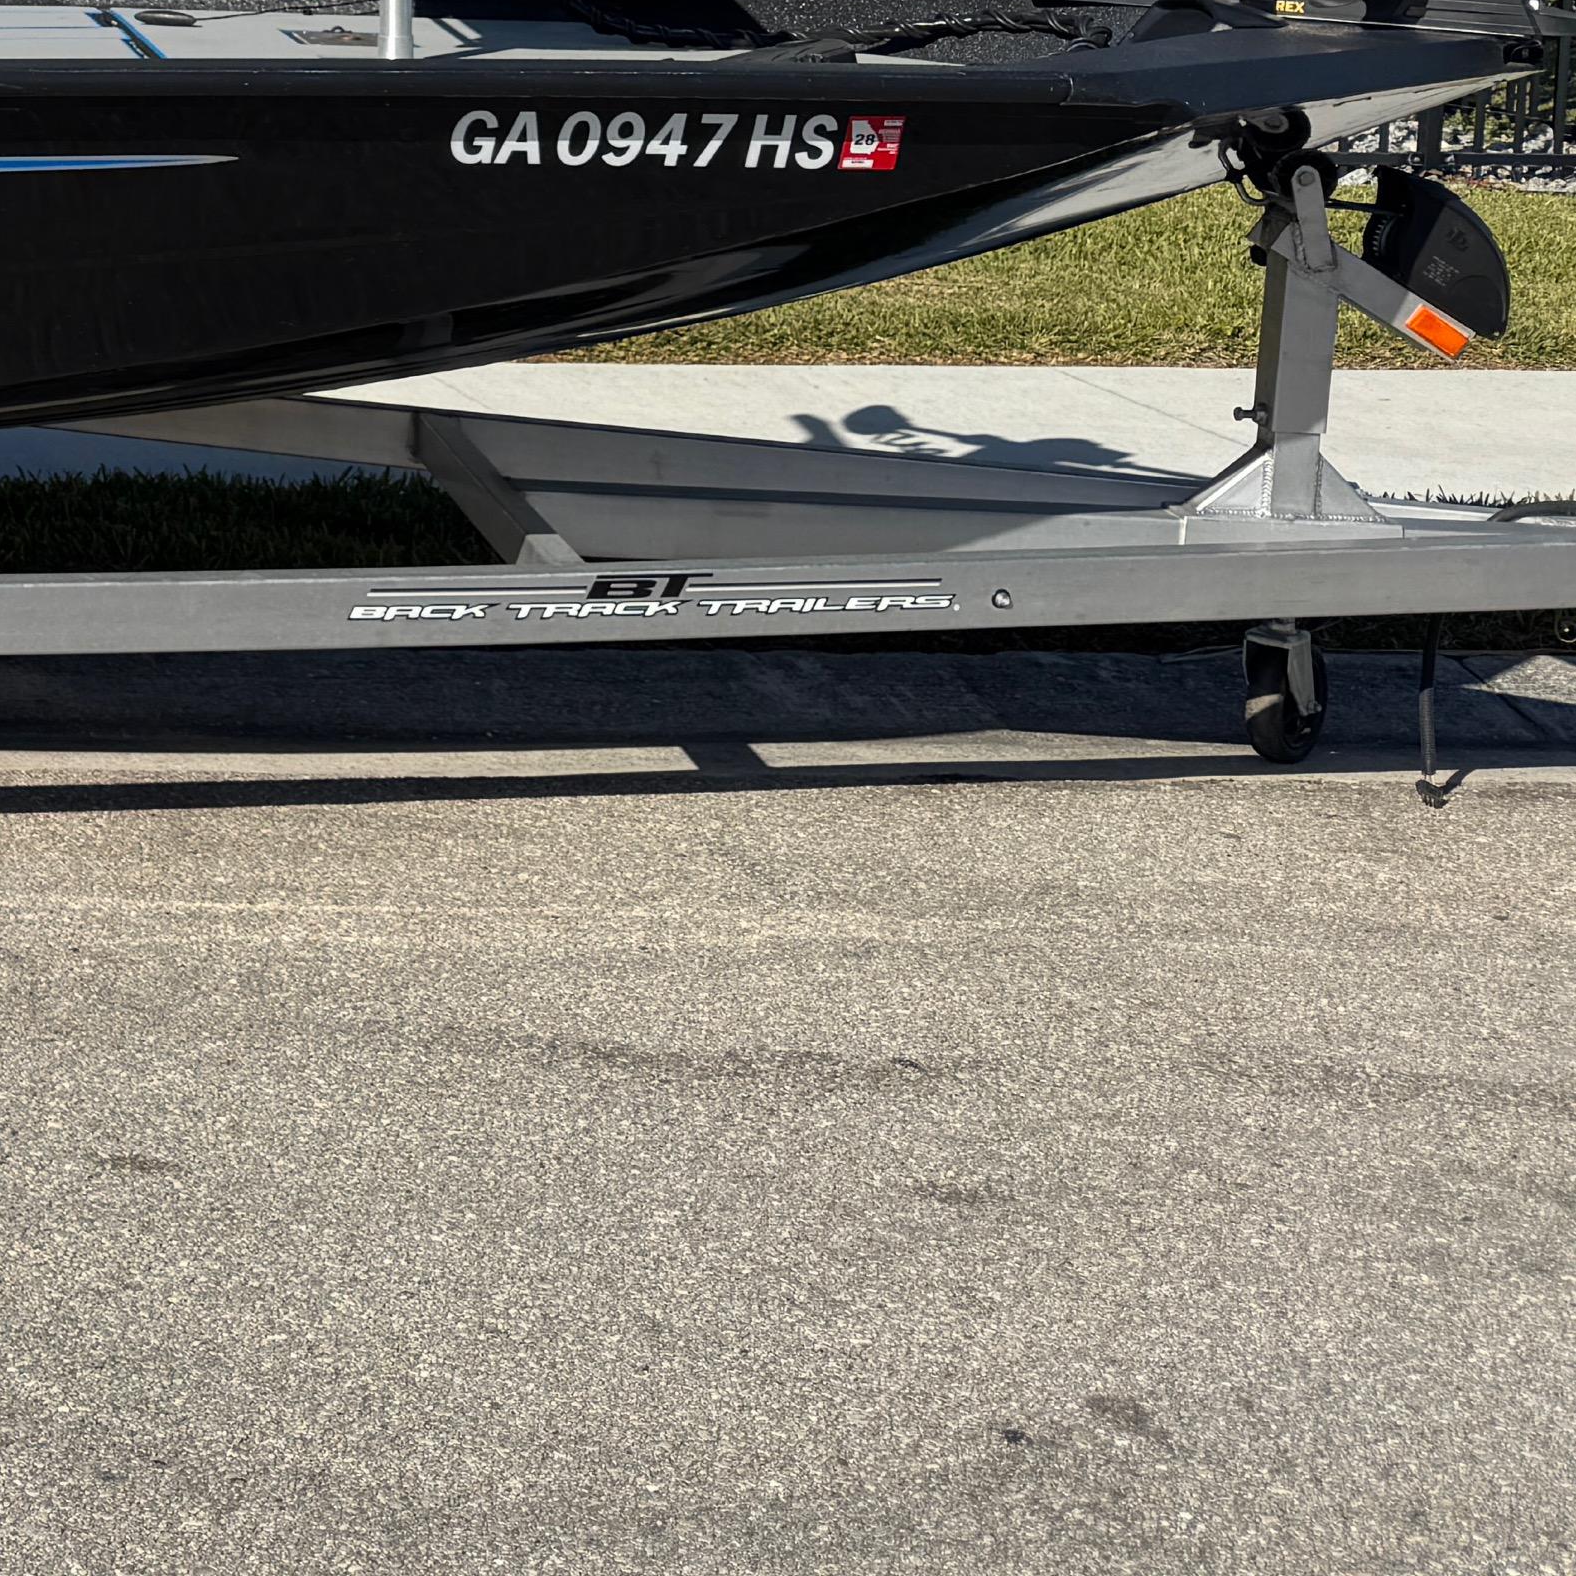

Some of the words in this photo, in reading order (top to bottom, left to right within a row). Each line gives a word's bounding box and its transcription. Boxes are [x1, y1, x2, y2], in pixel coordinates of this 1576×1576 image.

[450, 110, 542, 166] GA
[556, 111, 740, 168] 0947
[744, 114, 839, 170] HS
[854, 133, 876, 146] 28
[586, 574, 714, 599] BT
[348, 603, 501, 622] BACK
[506, 599, 694, 621] TRACK
[697, 593, 956, 616] TRAILERS
